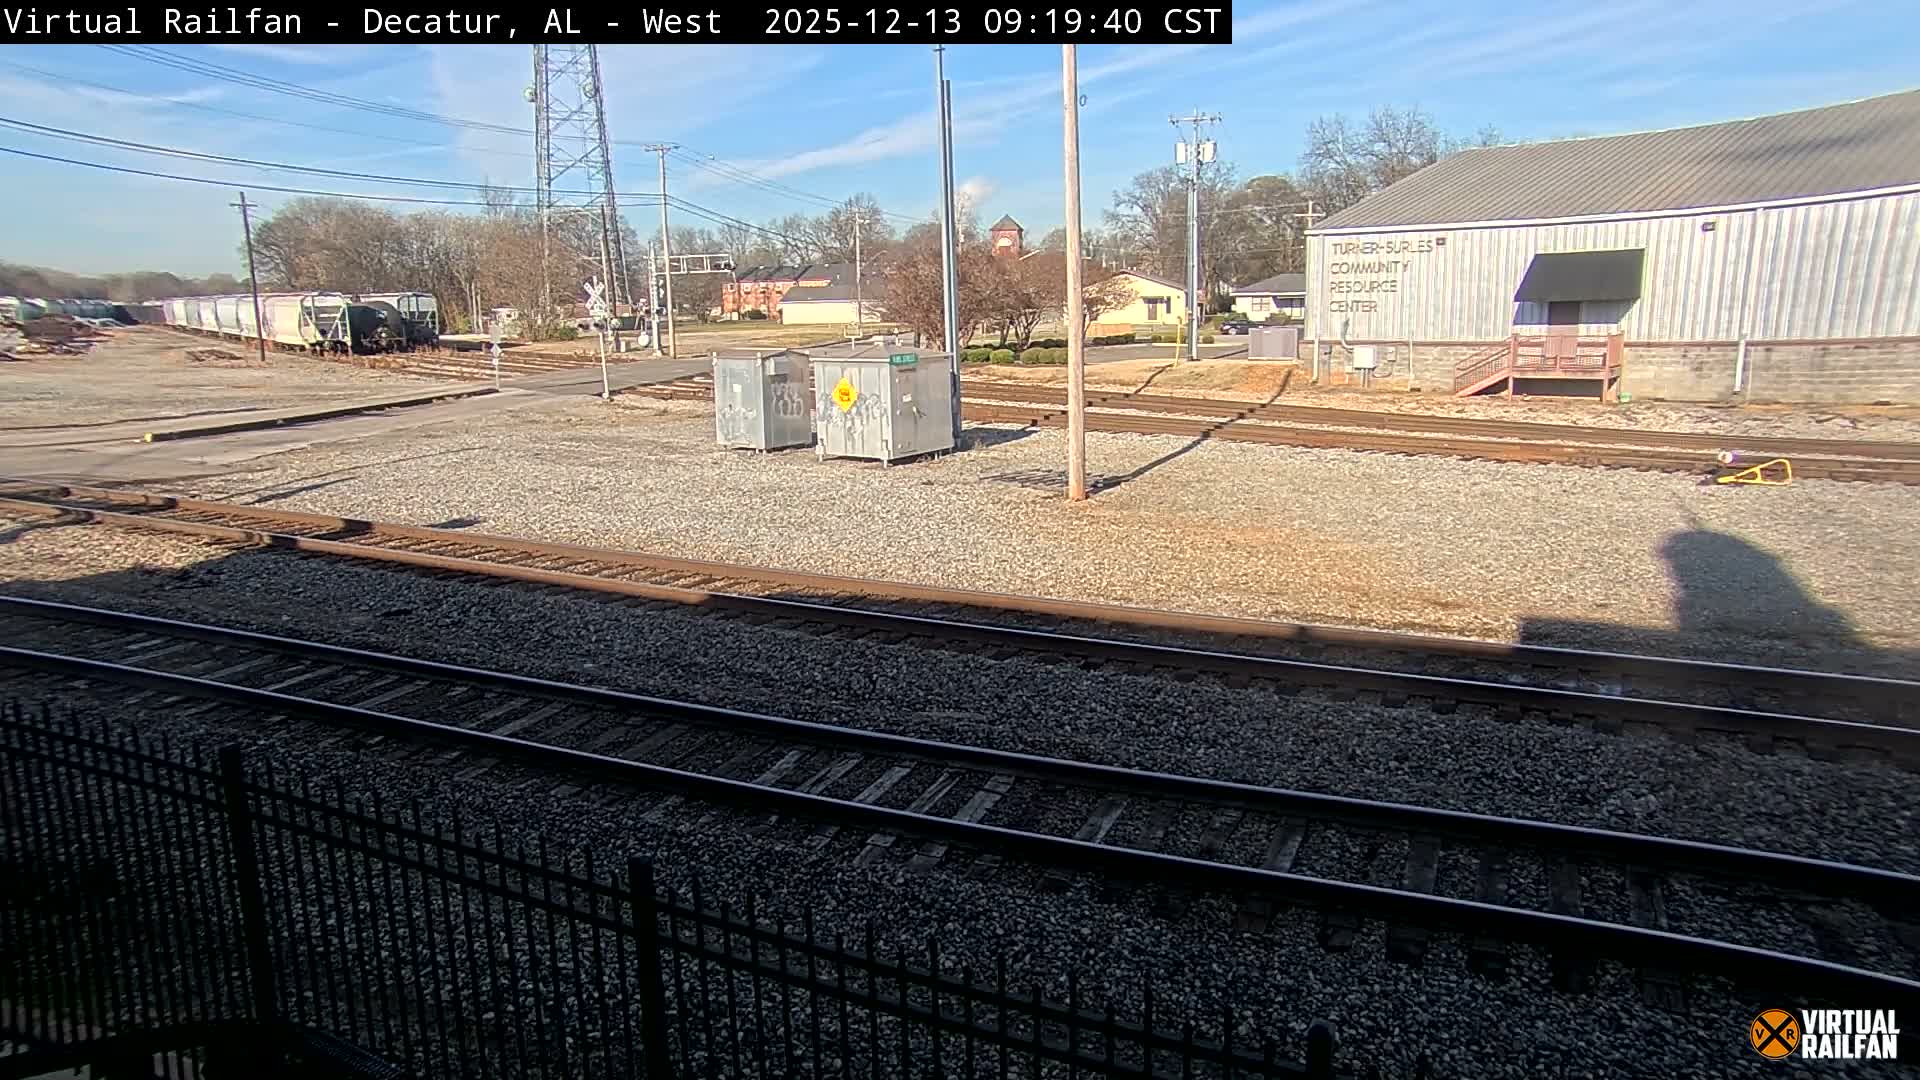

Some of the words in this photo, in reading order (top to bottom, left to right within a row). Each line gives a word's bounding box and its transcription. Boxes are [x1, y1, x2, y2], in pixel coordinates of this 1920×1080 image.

[1332, 240, 1433, 255] TURNER-SURLES
[1330, 260, 1412, 275] COMMUNITY
[1330, 280, 1398, 293] RESOURCE
[1329, 300, 1378, 313] CENTER
